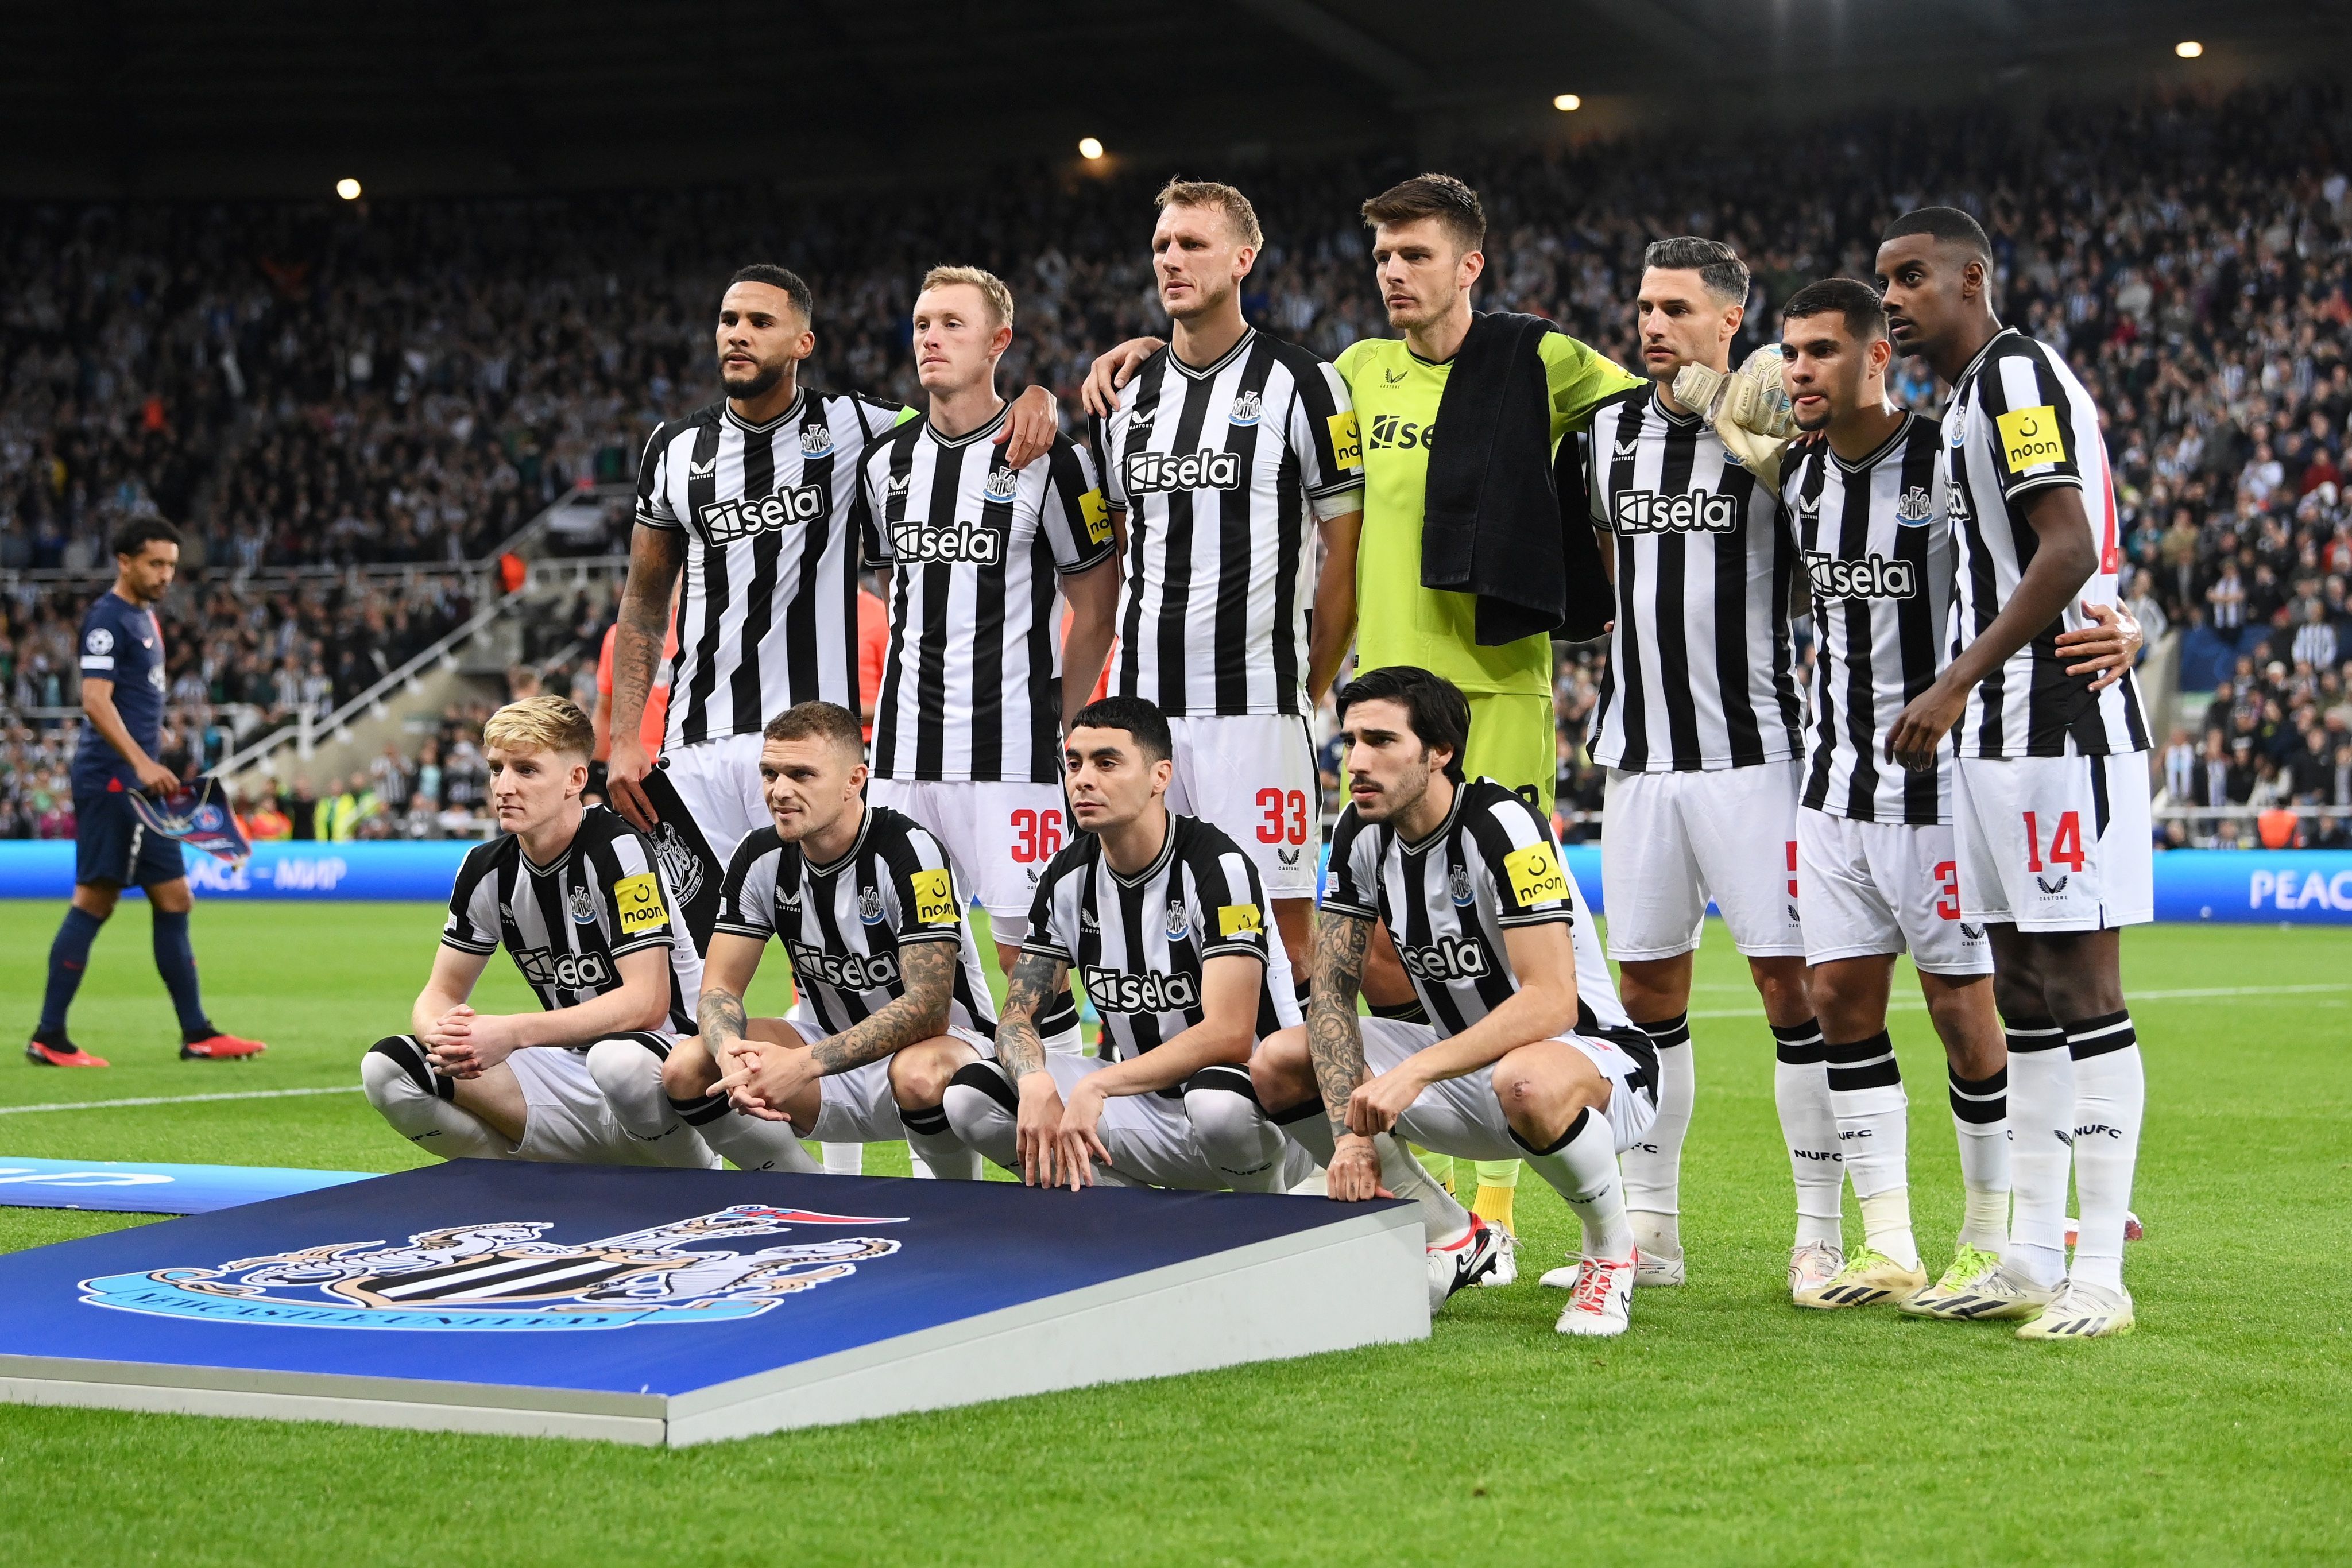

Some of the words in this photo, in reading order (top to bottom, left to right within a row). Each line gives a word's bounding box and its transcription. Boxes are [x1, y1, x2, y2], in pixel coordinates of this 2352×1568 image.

[1338, 443, 1361, 460] no
[1397, 423, 1435, 451] se
[2010, 441, 2058, 462] noon
[1160, 451, 1235, 487] sela
[742, 489, 819, 532] sela
[1090, 518, 1110, 535] no
[1651, 493, 1731, 528] sela
[920, 525, 995, 560] sela
[1833, 558, 1910, 594] sela
[1256, 788, 1307, 845] 33
[1011, 809, 1062, 863] 36
[2022, 811, 2085, 873] 14
[187, 859, 252, 890] ACE
[1519, 876, 1562, 901] noon
[1933, 860, 1962, 920] 3
[2250, 869, 2352, 912] PEAC
[624, 905, 663, 924] noon
[775, 904, 801, 913] CASTORE
[824, 956, 897, 986] sela
[1405, 940, 1484, 977] sela
[1121, 974, 1194, 1009] sela
[1838, 1129, 1872, 1140] UFC
[2074, 1124, 2122, 1139] NUFC
[1794, 1149, 1842, 1162] NUFC
